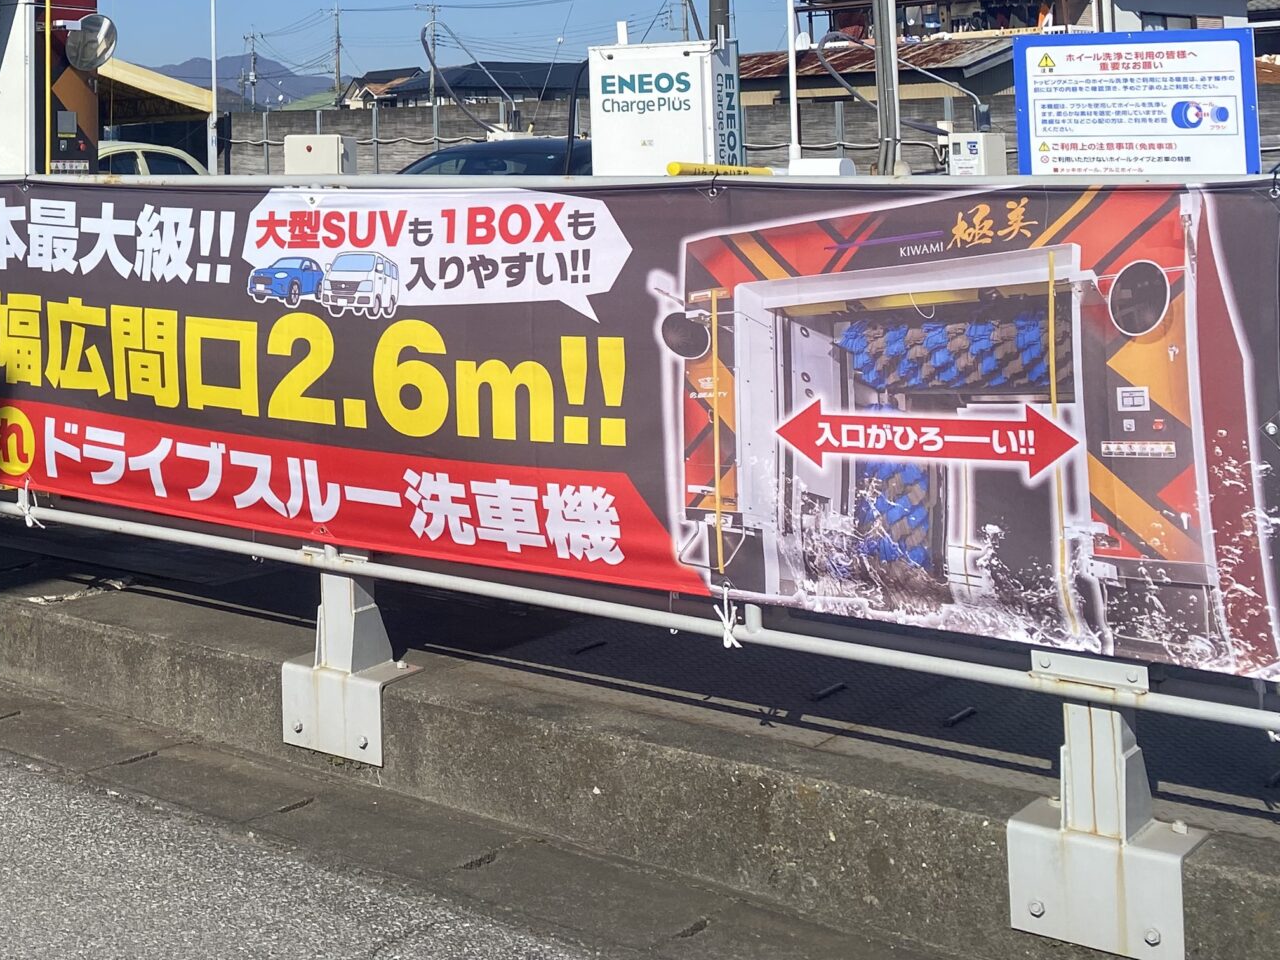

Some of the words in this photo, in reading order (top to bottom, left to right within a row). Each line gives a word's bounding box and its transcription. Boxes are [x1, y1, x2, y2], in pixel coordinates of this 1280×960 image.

[1066, 50, 1198, 61] ホイール洗浄ご利用の皆様へ
[1099, 61, 1163, 71] 重要なお願い
[601, 72, 691, 95] ENEOS
[725, 73, 738, 166] ENEOS
[255, 202, 597, 250] 大型SUVも1BOXも
[899, 242, 944, 257] KIWAMI
[946, 196, 1038, 250] 極美
[405, 248, 592, 292] 入りやすい!!
[43, 416, 625, 565] ドライブスルー洗車機
